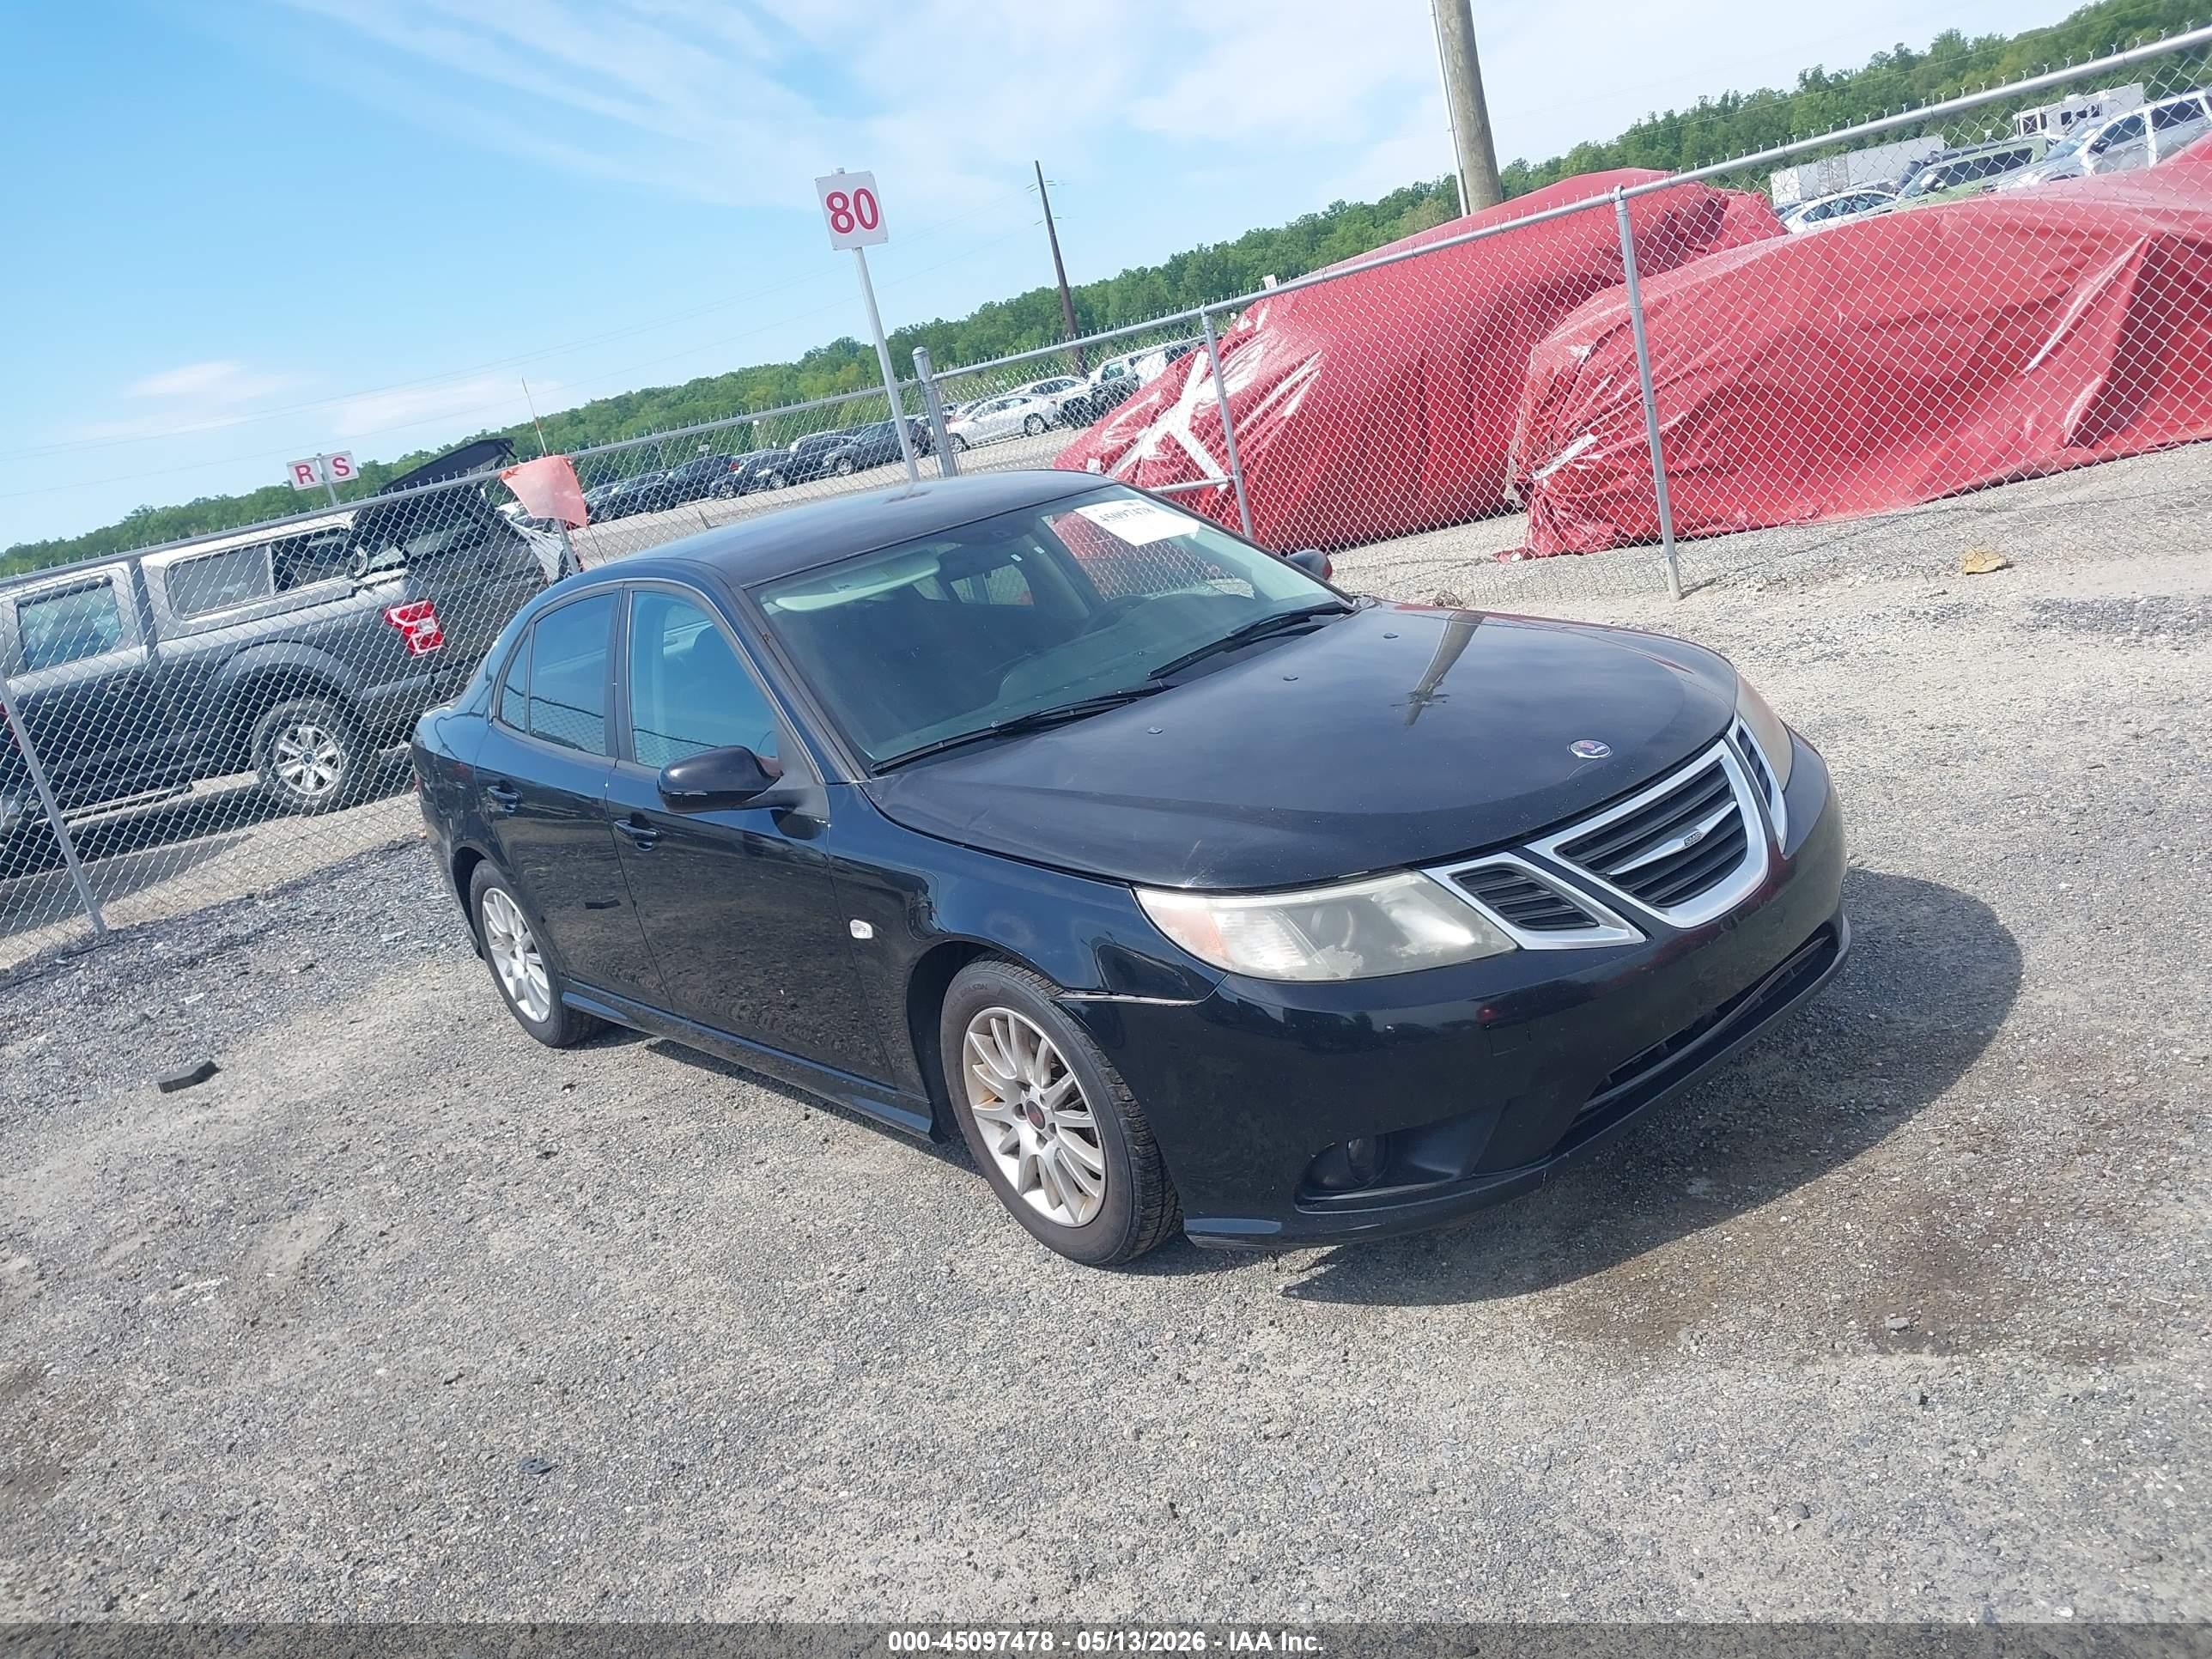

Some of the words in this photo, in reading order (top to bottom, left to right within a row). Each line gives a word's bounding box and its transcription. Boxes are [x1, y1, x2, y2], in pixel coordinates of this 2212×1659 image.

[826, 188, 878, 234] 80
[295, 465, 316, 484] R
[331, 457, 350, 477] S
